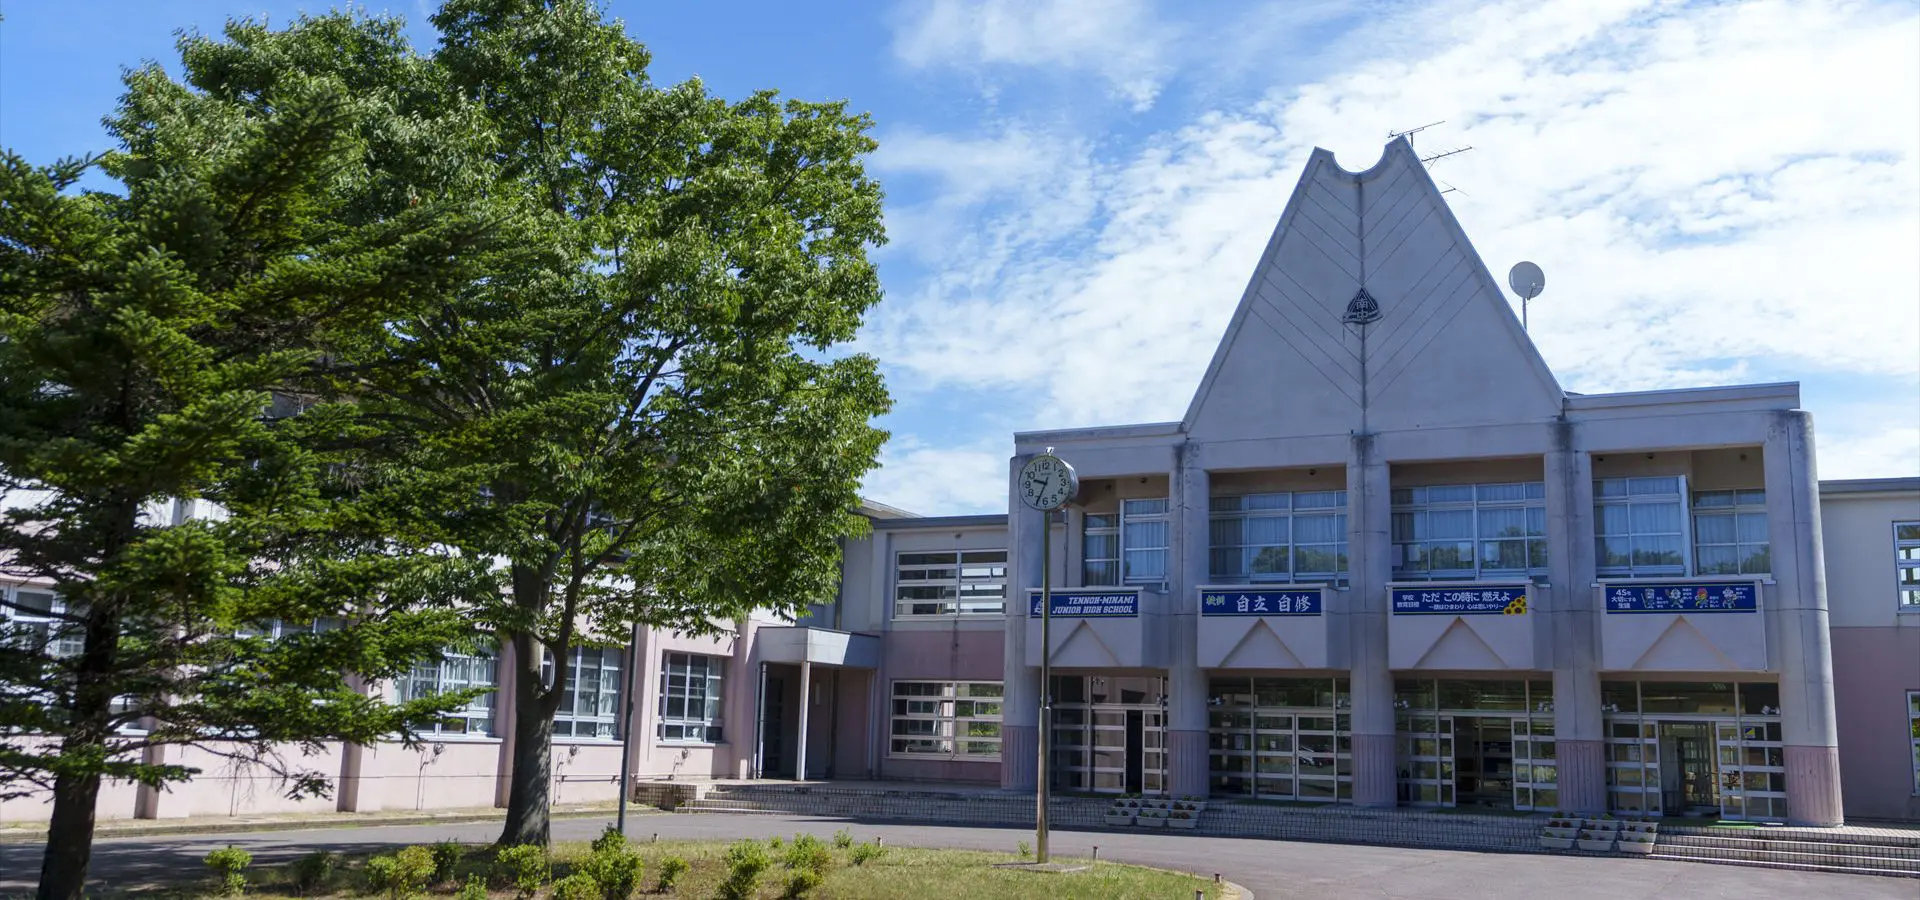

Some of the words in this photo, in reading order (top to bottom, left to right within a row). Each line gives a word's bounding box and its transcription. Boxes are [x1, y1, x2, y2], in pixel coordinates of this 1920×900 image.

[1034, 464, 1041, 472] 11
[1042, 462, 1050, 470] 12
[1025, 471, 1036, 480] 10
[1058, 469, 1064, 478] 2
[1025, 480, 1031, 489] 9
[1060, 478, 1066, 486] 3
[1028, 488, 1034, 496] 8
[1042, 496, 1048, 506] 6
[1052, 494, 1057, 502] 5
[1068, 596, 1134, 605] TENNOH-MINAMI
[1422, 592, 1440, 602] ただ
[1443, 592, 1480, 602] この時に
[1482, 591, 1510, 602] 燃えよ
[1236, 594, 1268, 612] 自立
[1278, 594, 1311, 612] 自修
[1052, 606, 1082, 614] JUNIOR
[1082, 606, 1102, 614] HIGH
[1103, 605, 1133, 614] SCHOOL
